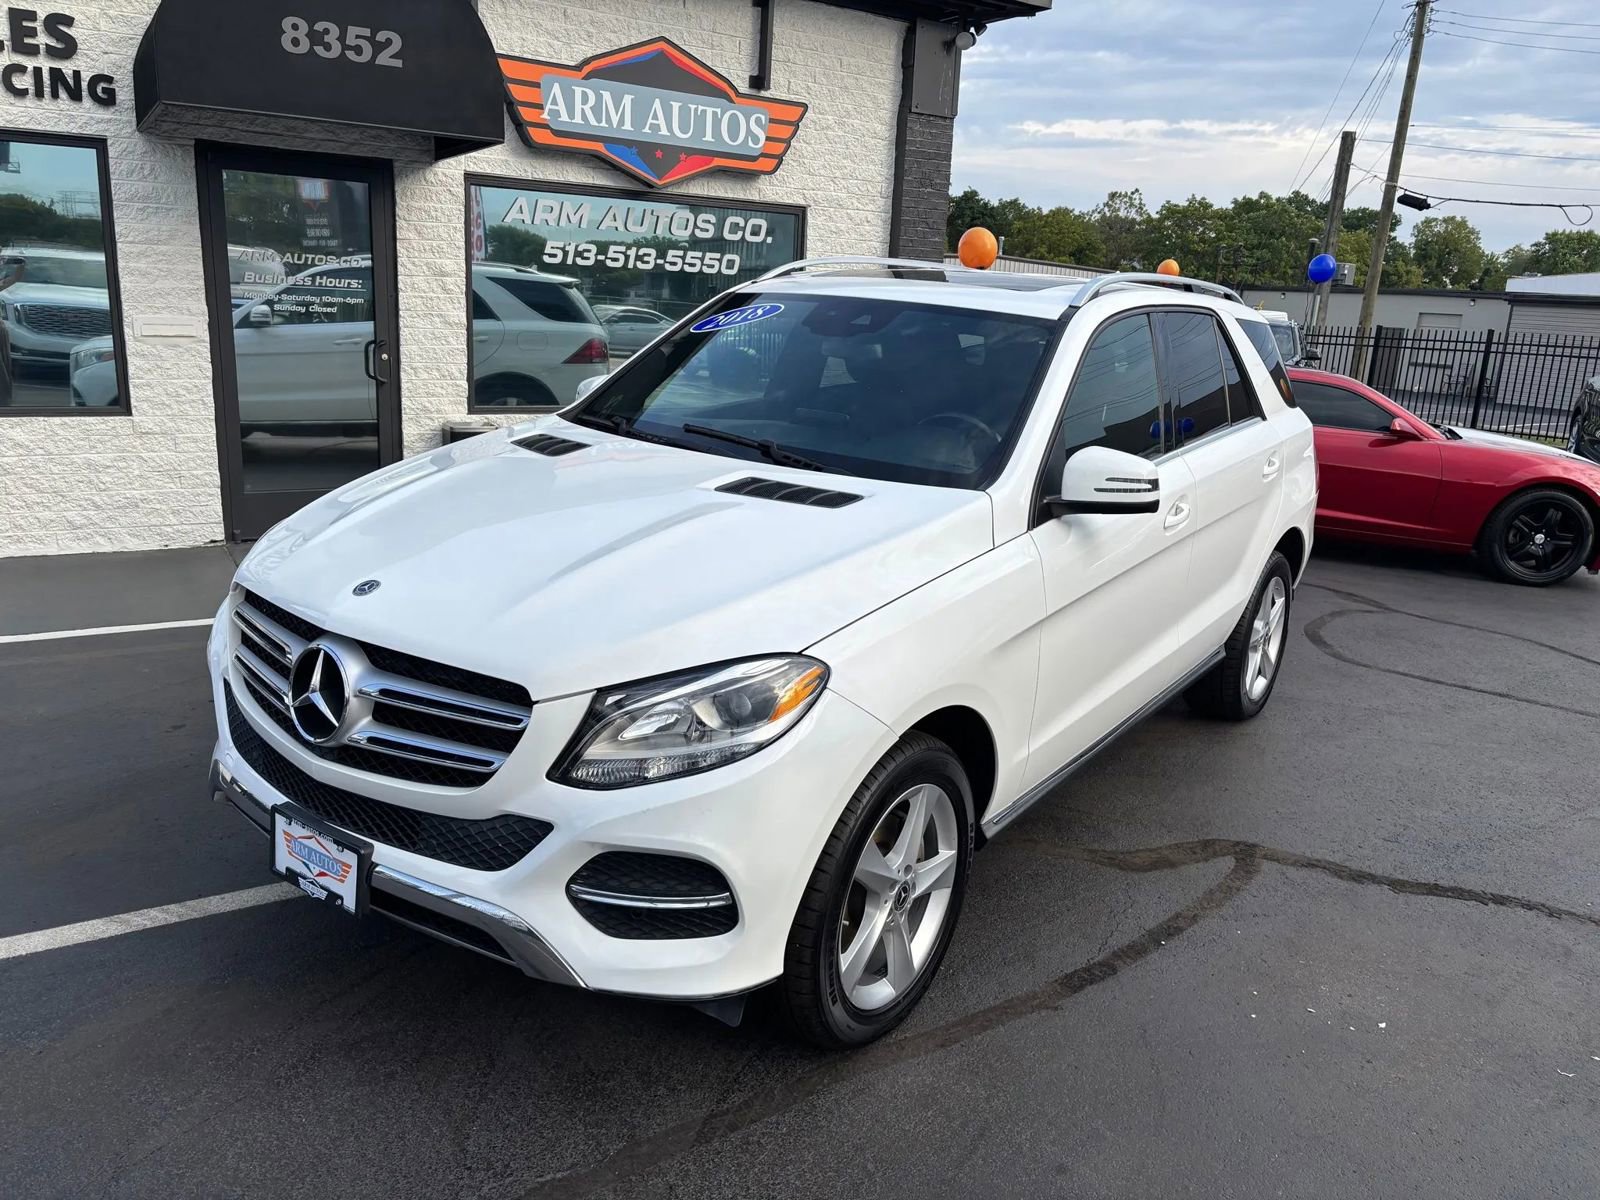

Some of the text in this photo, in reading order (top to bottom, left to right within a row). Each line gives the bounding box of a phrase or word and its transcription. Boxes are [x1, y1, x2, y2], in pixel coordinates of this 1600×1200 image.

[0, 7, 78, 60] ES
[280, 16, 404, 68] 8352
[2, 63, 117, 107] CING
[540, 82, 767, 149] ARM AUTOS
[503, 196, 589, 229] ARM
[597, 204, 716, 239] AUTOS
[723, 216, 774, 244] CO.
[239, 249, 277, 264] ARM
[280, 252, 337, 267] AUTOS
[543, 240, 741, 276] 513-513-5550
[243, 271, 363, 289] Business Hours:
[244, 291, 365, 305] Monday-Saturday 10am-6pm
[273, 304, 338, 313] Sunday Closed
[702, 305, 771, 330] 2018
[291, 839, 343, 875] ARM AUTOS
